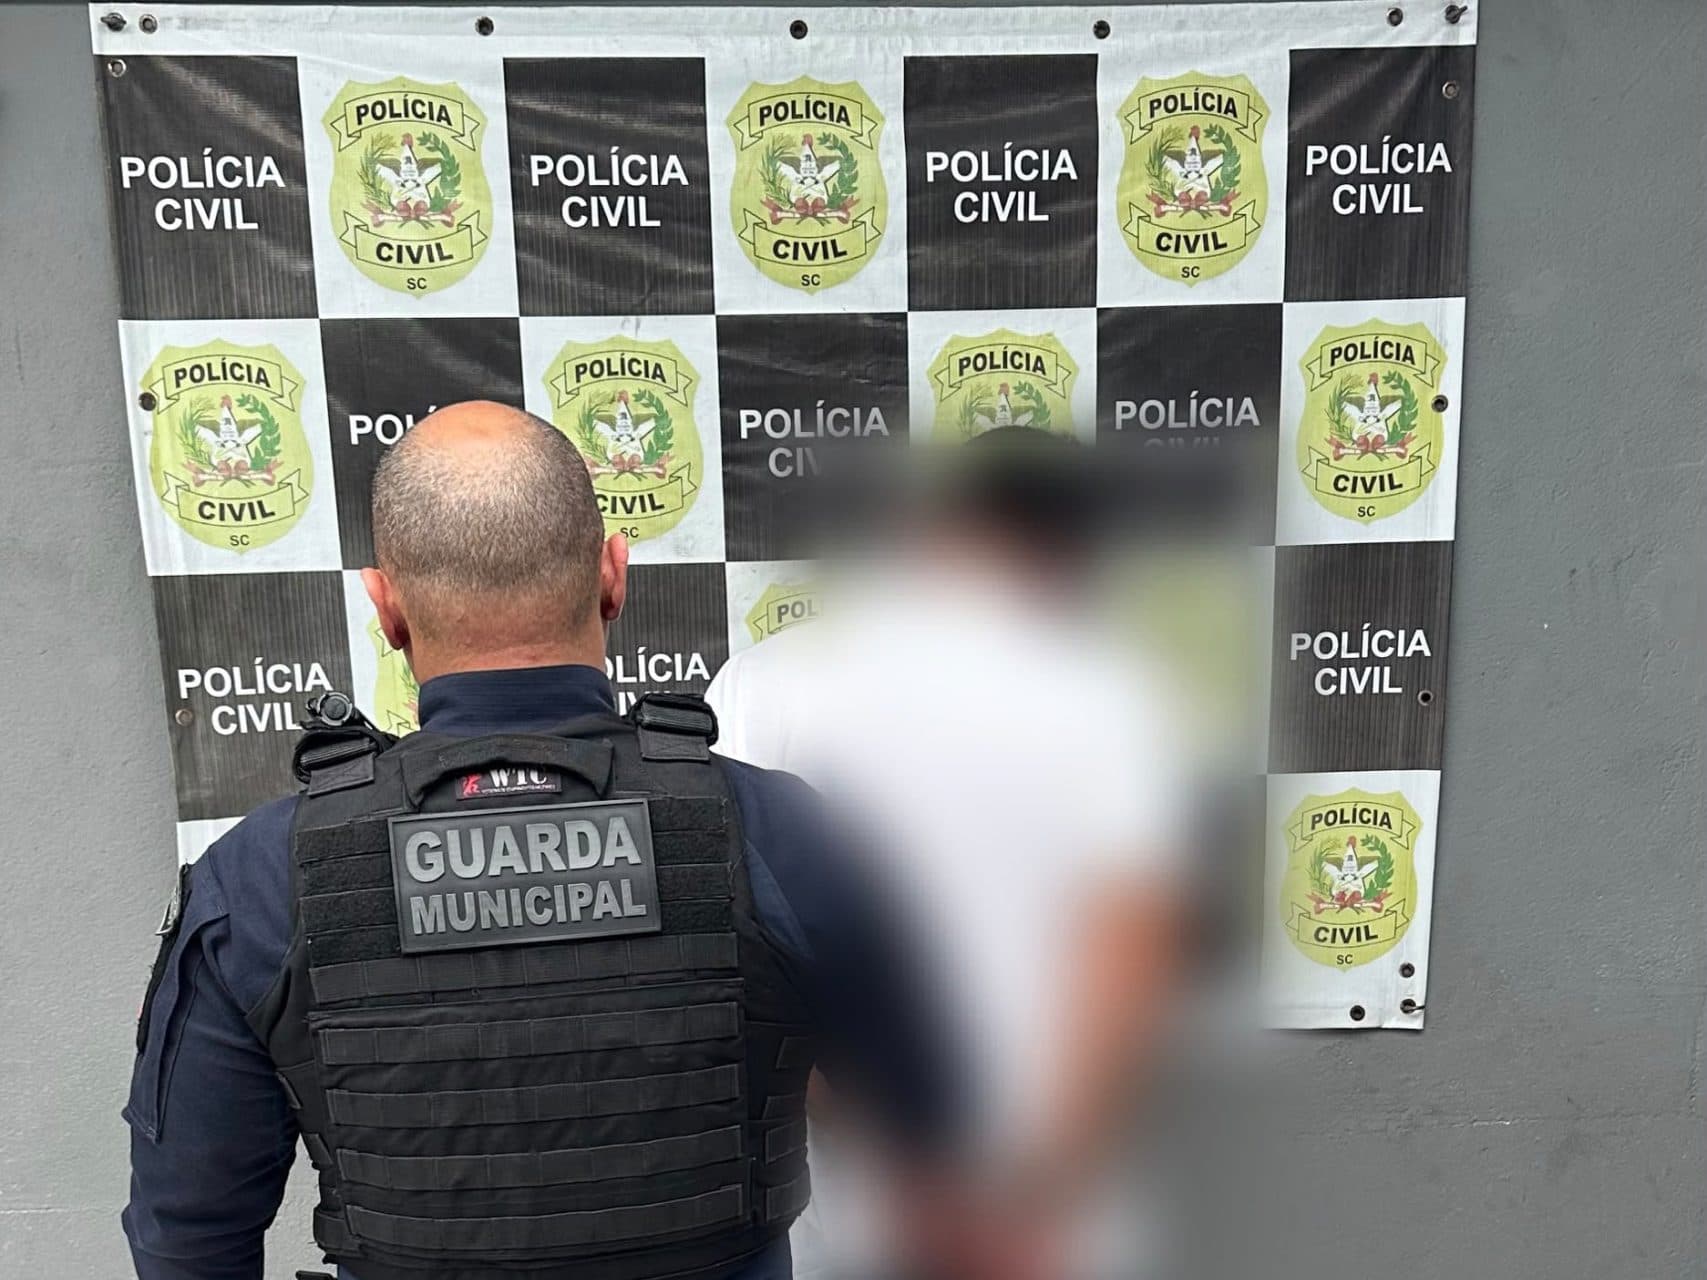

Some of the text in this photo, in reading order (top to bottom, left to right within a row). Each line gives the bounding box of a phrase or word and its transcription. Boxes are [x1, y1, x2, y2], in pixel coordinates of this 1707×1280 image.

[356, 94, 452, 126] POLÍCIA
[759, 95, 851, 126] POLÍCIA
[1149, 88, 1238, 118] POLÍCIA
[121, 148, 285, 188] POLÍCIA
[531, 146, 688, 186] POLÍCIA
[927, 142, 1077, 182] POLÍCIA
[1306, 136, 1452, 175] POLÍCIA
[562, 196, 660, 227] CIVIL
[955, 191, 1048, 222] CIVIL
[1333, 184, 1423, 214] CIVIL
[155, 199, 258, 230] CIVIL
[376, 242, 453, 265] CIVIL
[773, 239, 847, 261] CIVIL
[1156, 231, 1228, 254] CIVIL
[407, 278, 427, 290] SC
[802, 274, 820, 286] SC
[1182, 266, 1200, 278] SC
[959, 346, 1046, 376] POLÍCIA
[1331, 336, 1415, 366] POLÍCIA
[175, 357, 270, 388] POLÍCIA
[575, 353, 666, 383] POLÍCIA
[740, 400, 889, 439] POLÍCIA
[1116, 390, 1260, 430] POLÍCIA
[1333, 473, 1403, 493] CIVIL
[199, 500, 275, 521] CIVIL
[594, 493, 666, 514] CIVIL
[1358, 506, 1375, 517] SC
[230, 535, 249, 546] SC
[620, 527, 639, 538] SC
[1291, 623, 1431, 660] POLÍCIA
[178, 657, 333, 699] POLÍCIA
[1315, 667, 1402, 695] CIVIL
[212, 702, 303, 735] CIVIL
[1311, 804, 1392, 830] POLÍCIA
[405, 816, 642, 883] GUARDA
[409, 878, 647, 935] MUNICIPAL
[1314, 925, 1378, 943] CIVIL
[1337, 954, 1353, 965] SC
